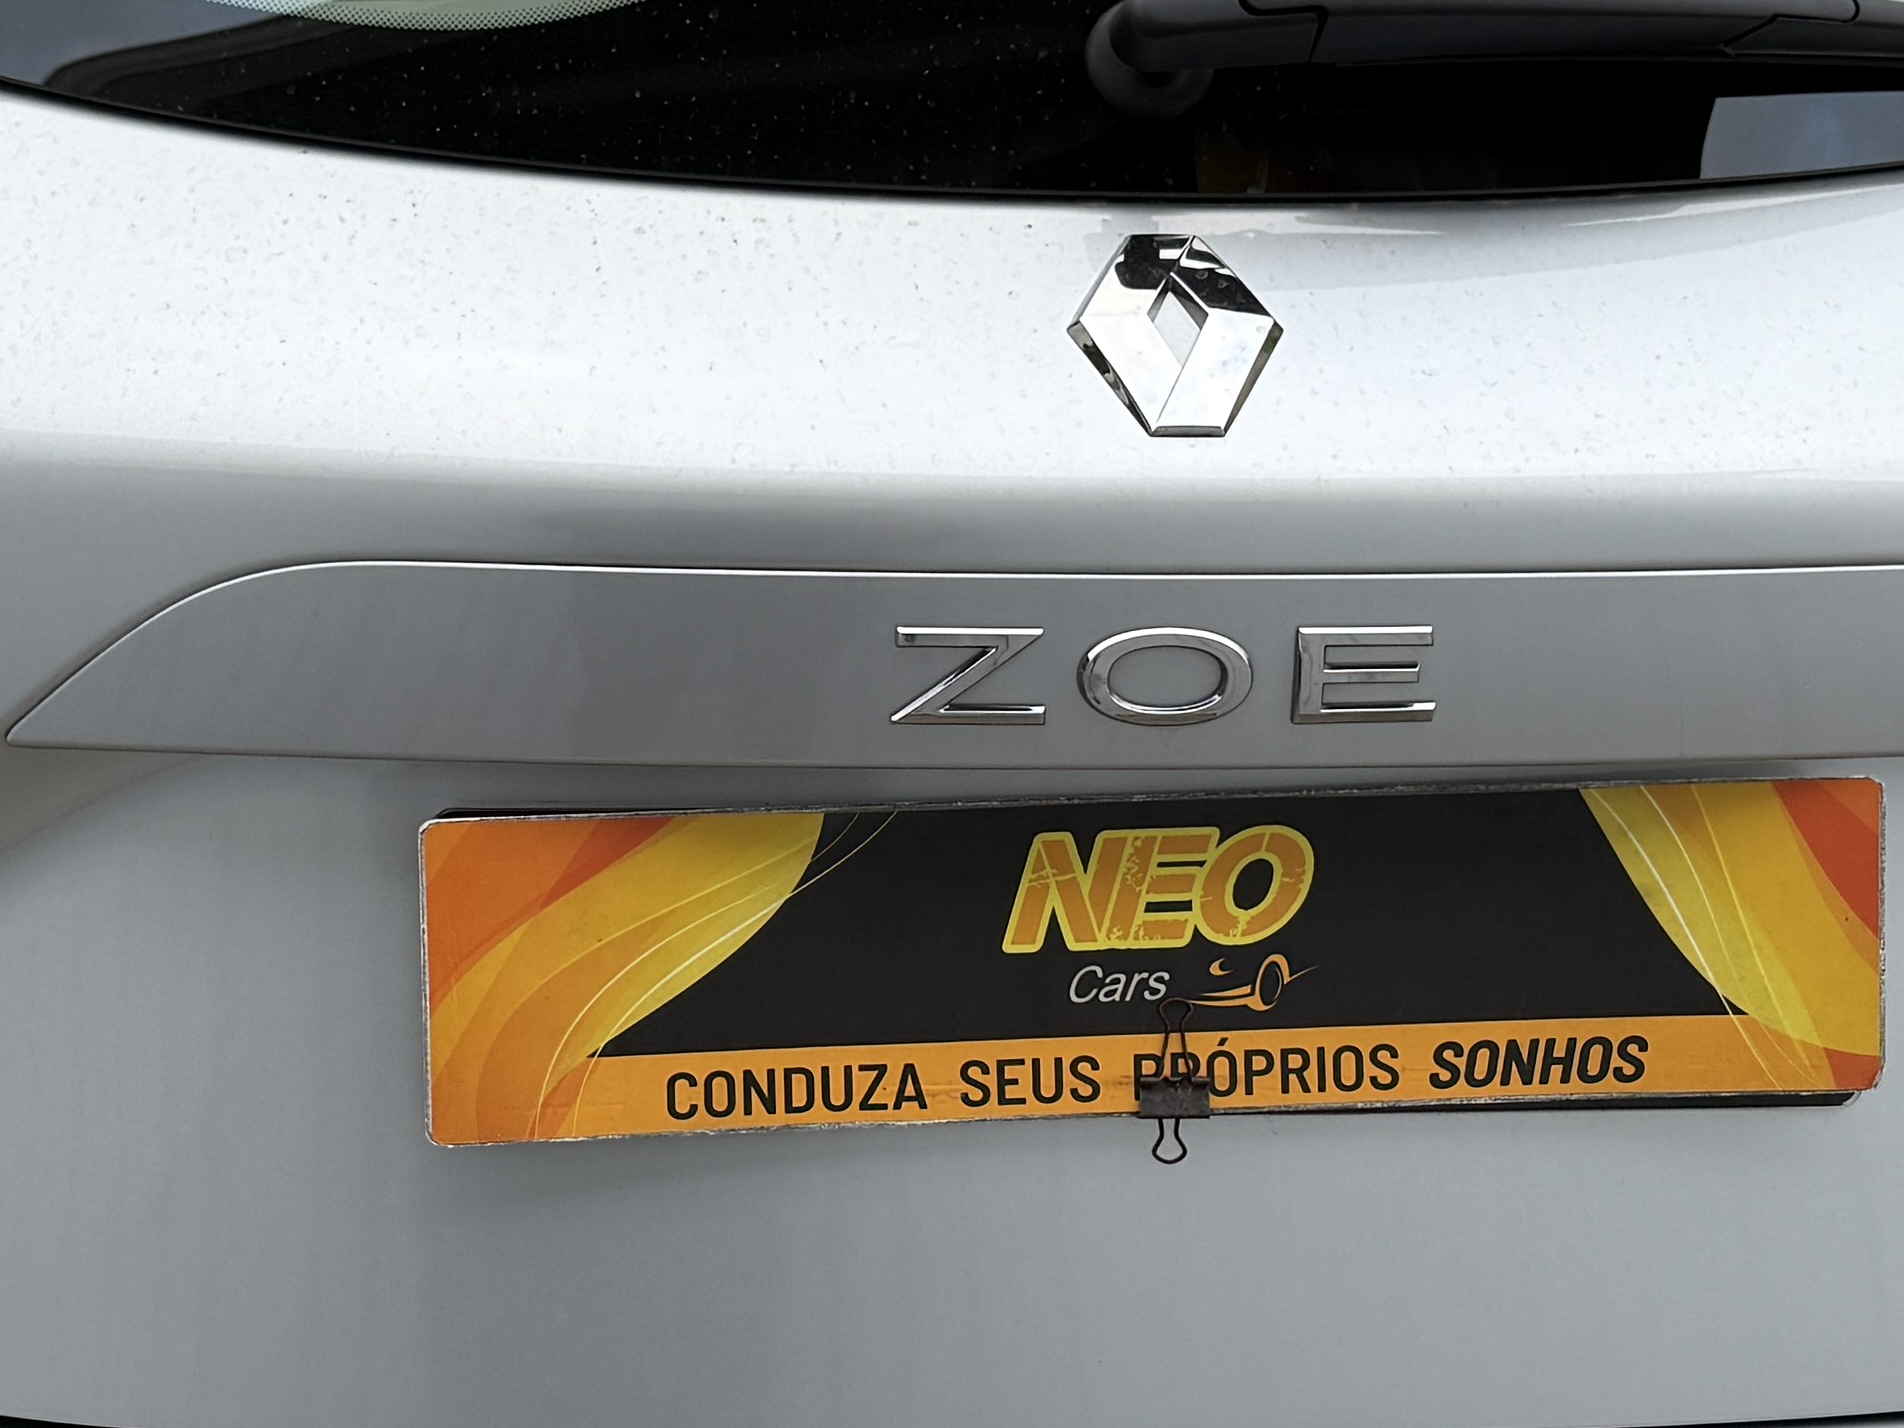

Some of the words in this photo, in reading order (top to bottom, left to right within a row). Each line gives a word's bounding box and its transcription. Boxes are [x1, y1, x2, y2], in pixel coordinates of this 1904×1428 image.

[889, 625, 1438, 726] ZOE
[1001, 824, 1315, 954] NEO
[1069, 965, 1170, 1004] Cars
[666, 1062, 929, 1121] CONDUZA
[959, 1054, 1102, 1108] SEUS
[1428, 1034, 1650, 1090] SONHOS
